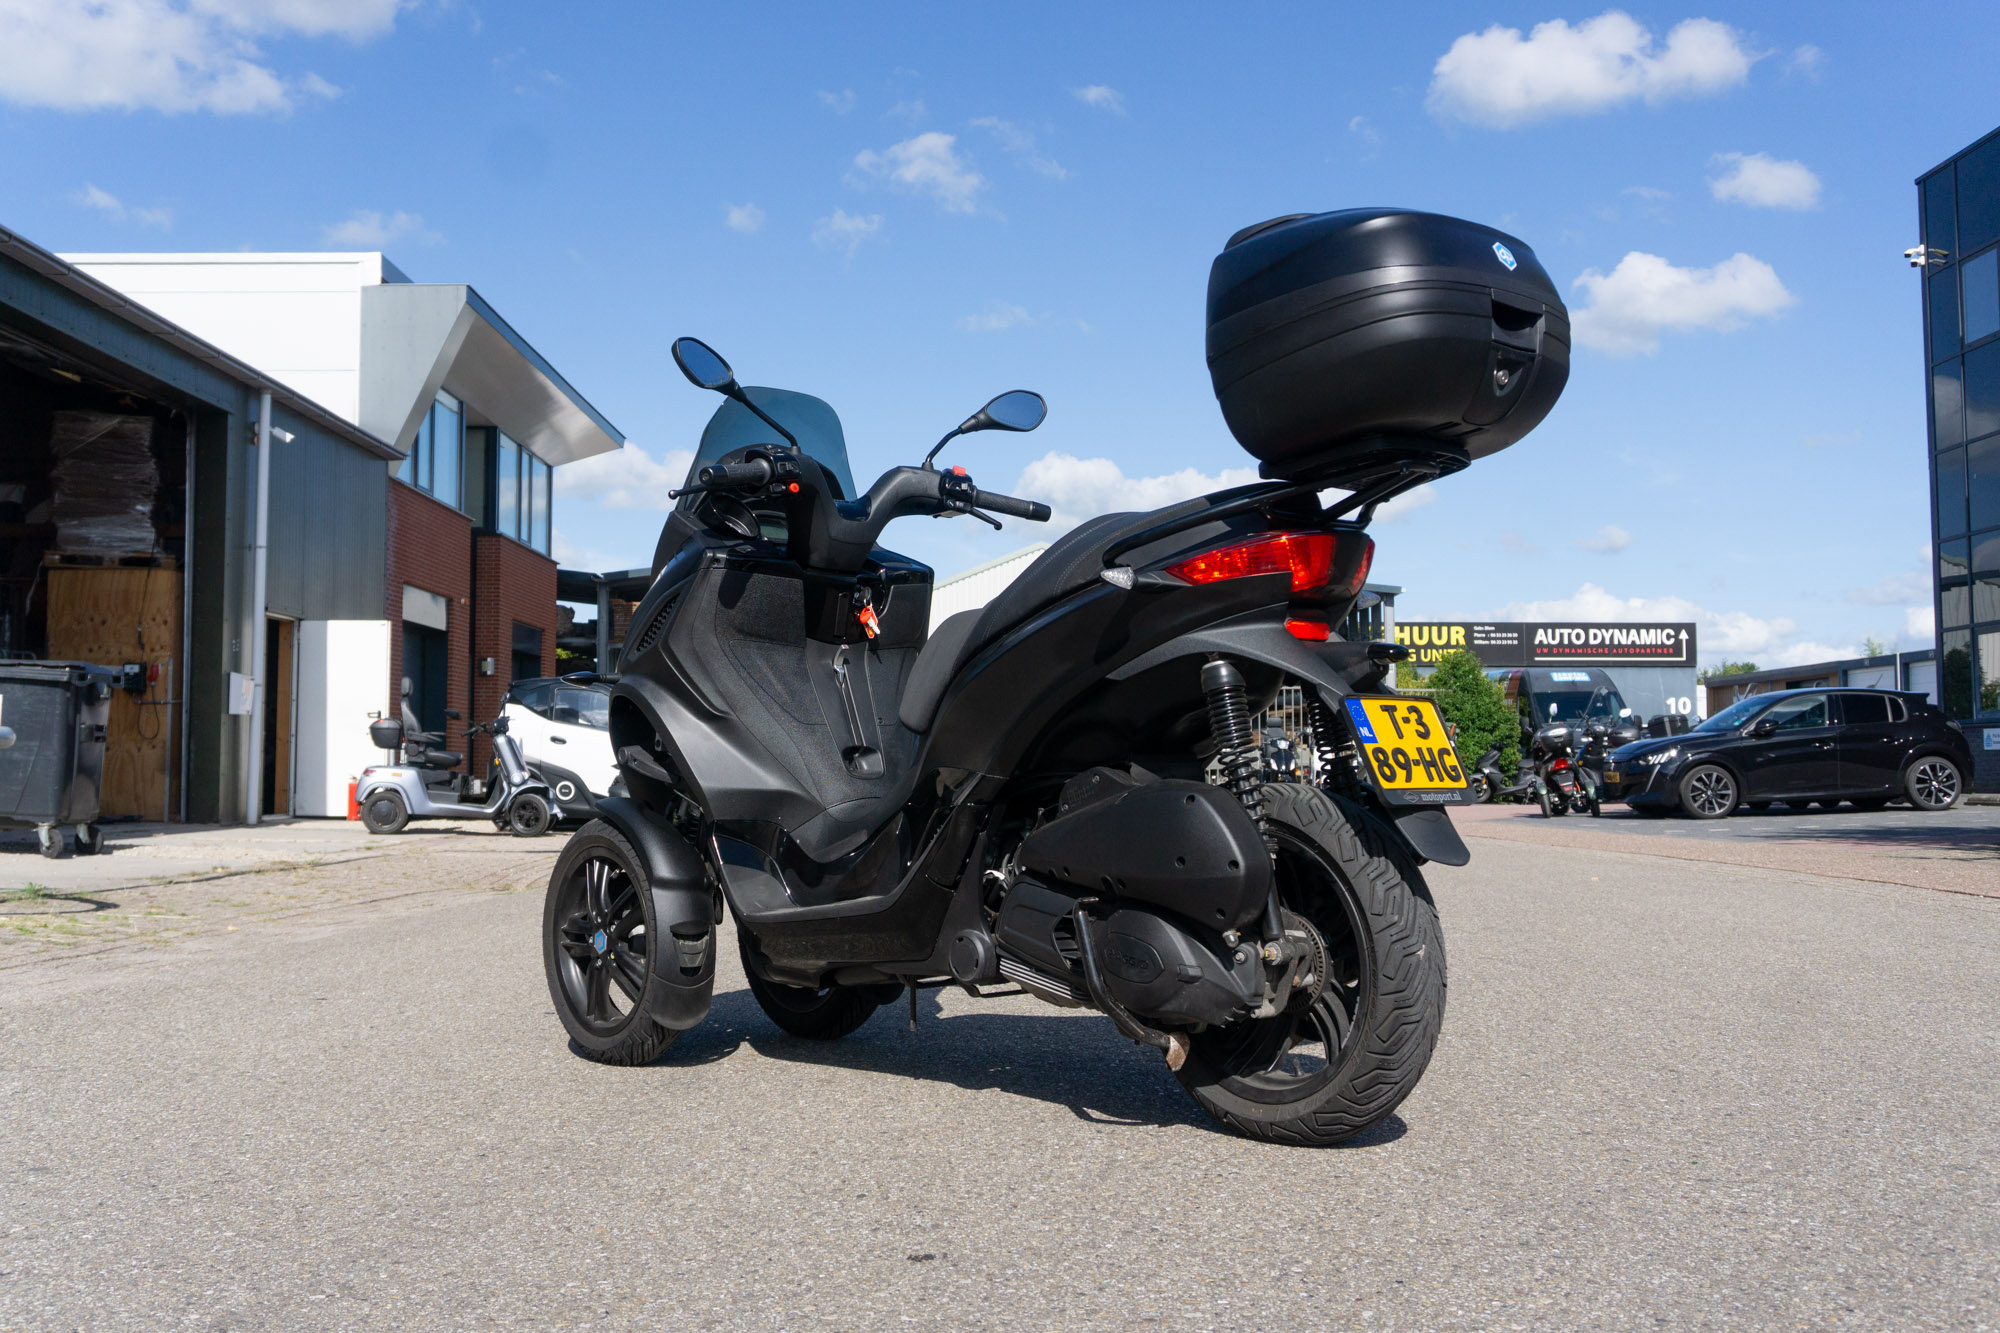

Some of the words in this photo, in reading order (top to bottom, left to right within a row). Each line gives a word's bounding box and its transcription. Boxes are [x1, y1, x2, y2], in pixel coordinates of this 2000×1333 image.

[1534, 628, 1586, 645] AUTO
[1588, 628, 1676, 645] DYNAMIC
[1665, 696, 1692, 715] 10
[1379, 704, 1431, 740] T-3
[1359, 726, 1373, 737] NL
[1371, 746, 1463, 783] 89-HG
[1420, 790, 1462, 803] motoport.nl
